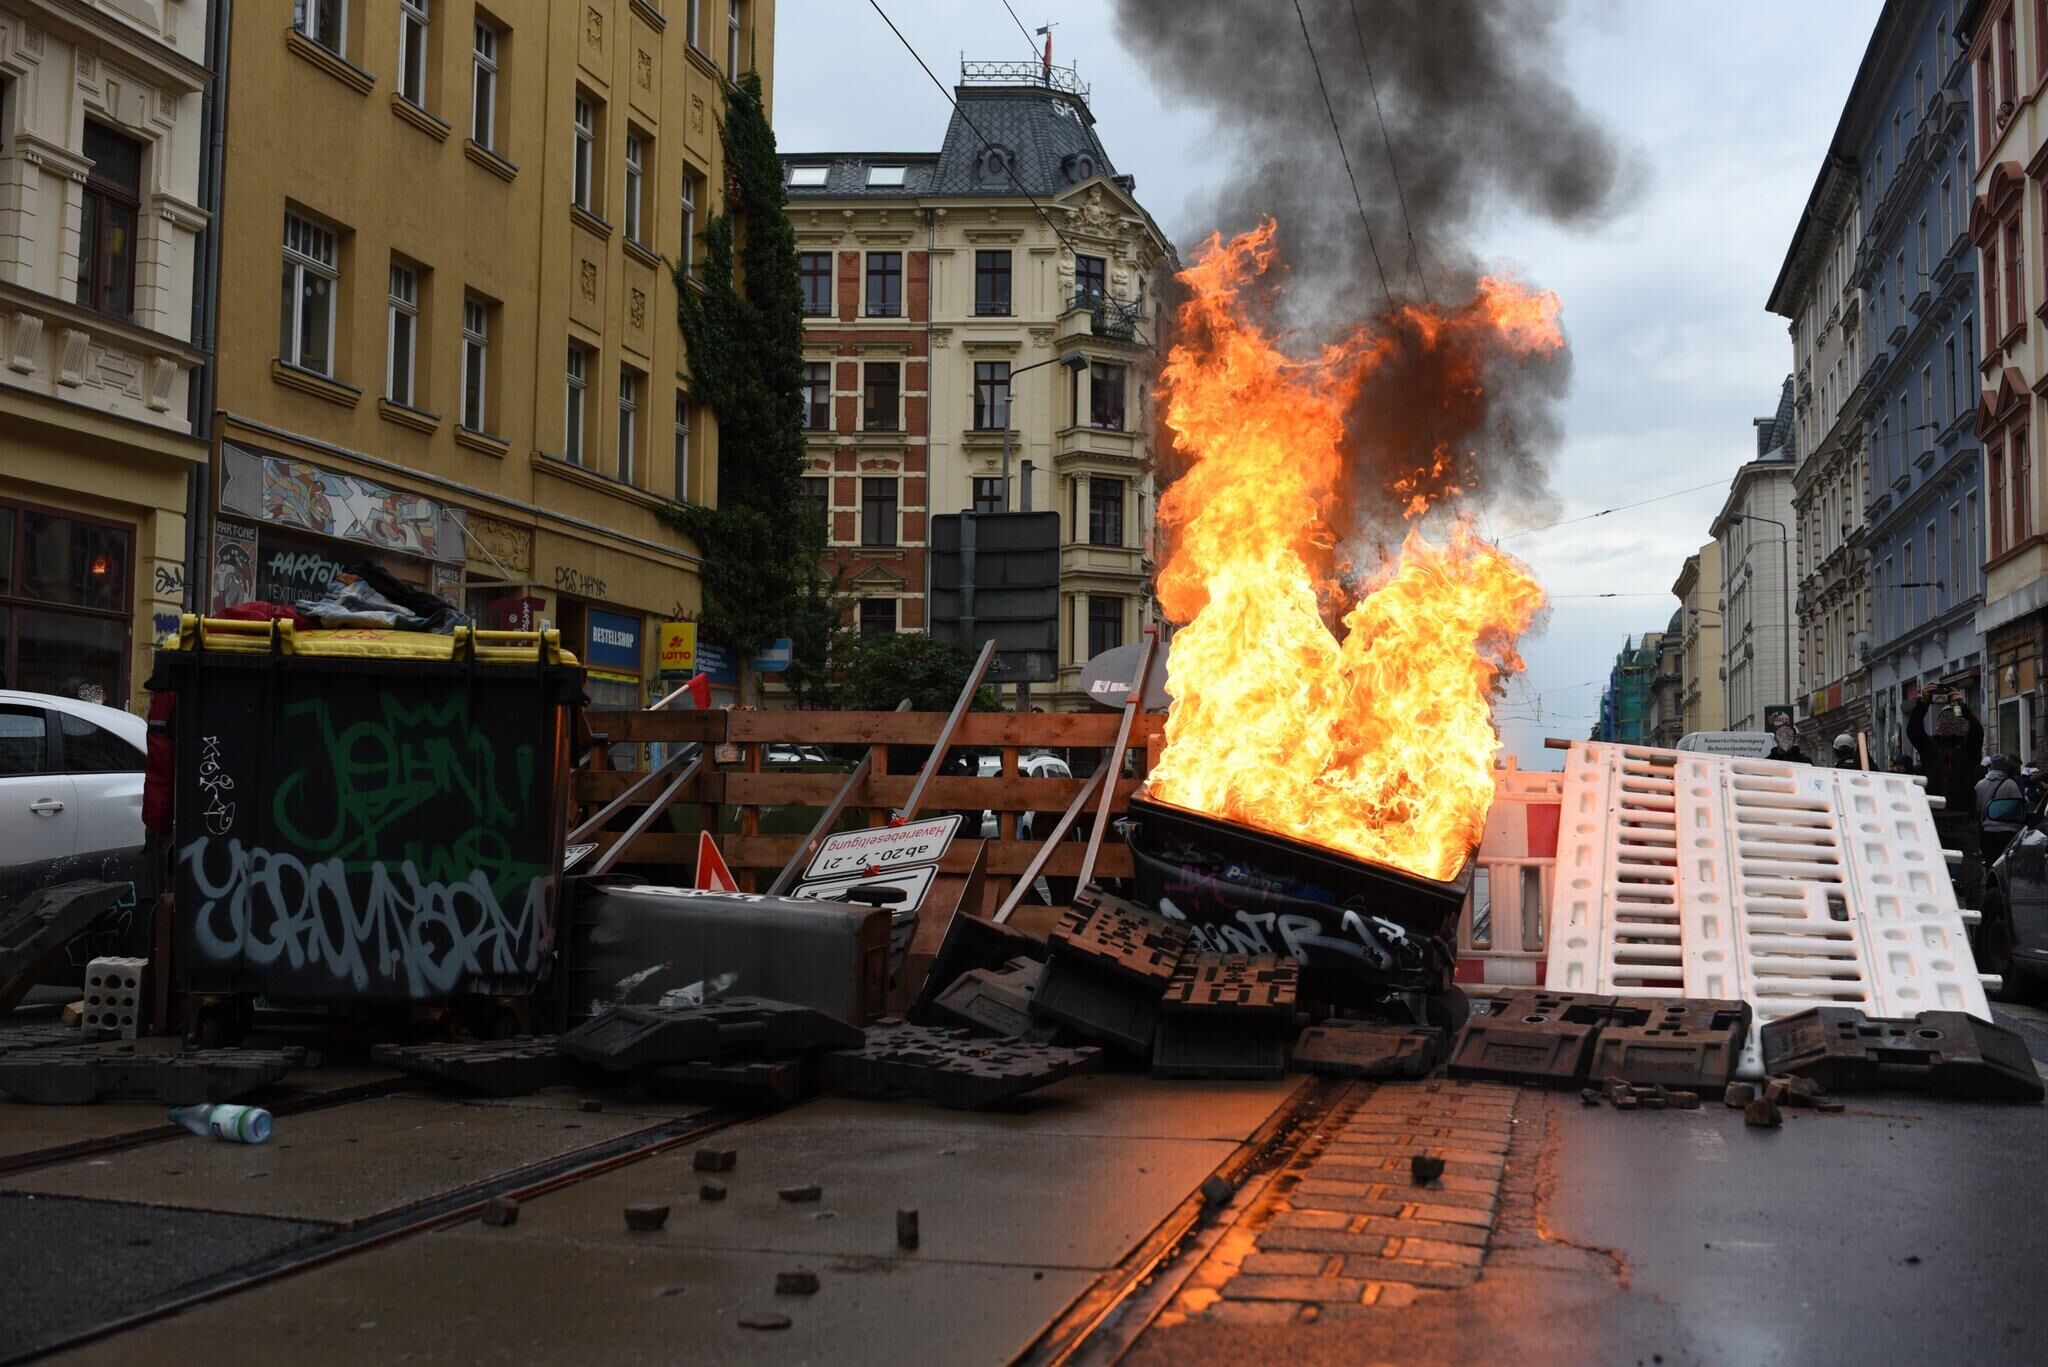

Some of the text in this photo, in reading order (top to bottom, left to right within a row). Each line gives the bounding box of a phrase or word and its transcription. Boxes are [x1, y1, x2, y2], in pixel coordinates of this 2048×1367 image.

[268, 552, 344, 589] PARTON
[267, 584, 324, 603] TEXTILDRUC
[593, 627, 634, 648] BESTELLSHOP
[662, 651, 691, 660] LOTTO
[828, 824, 947, 851] Havariebeseitigung
